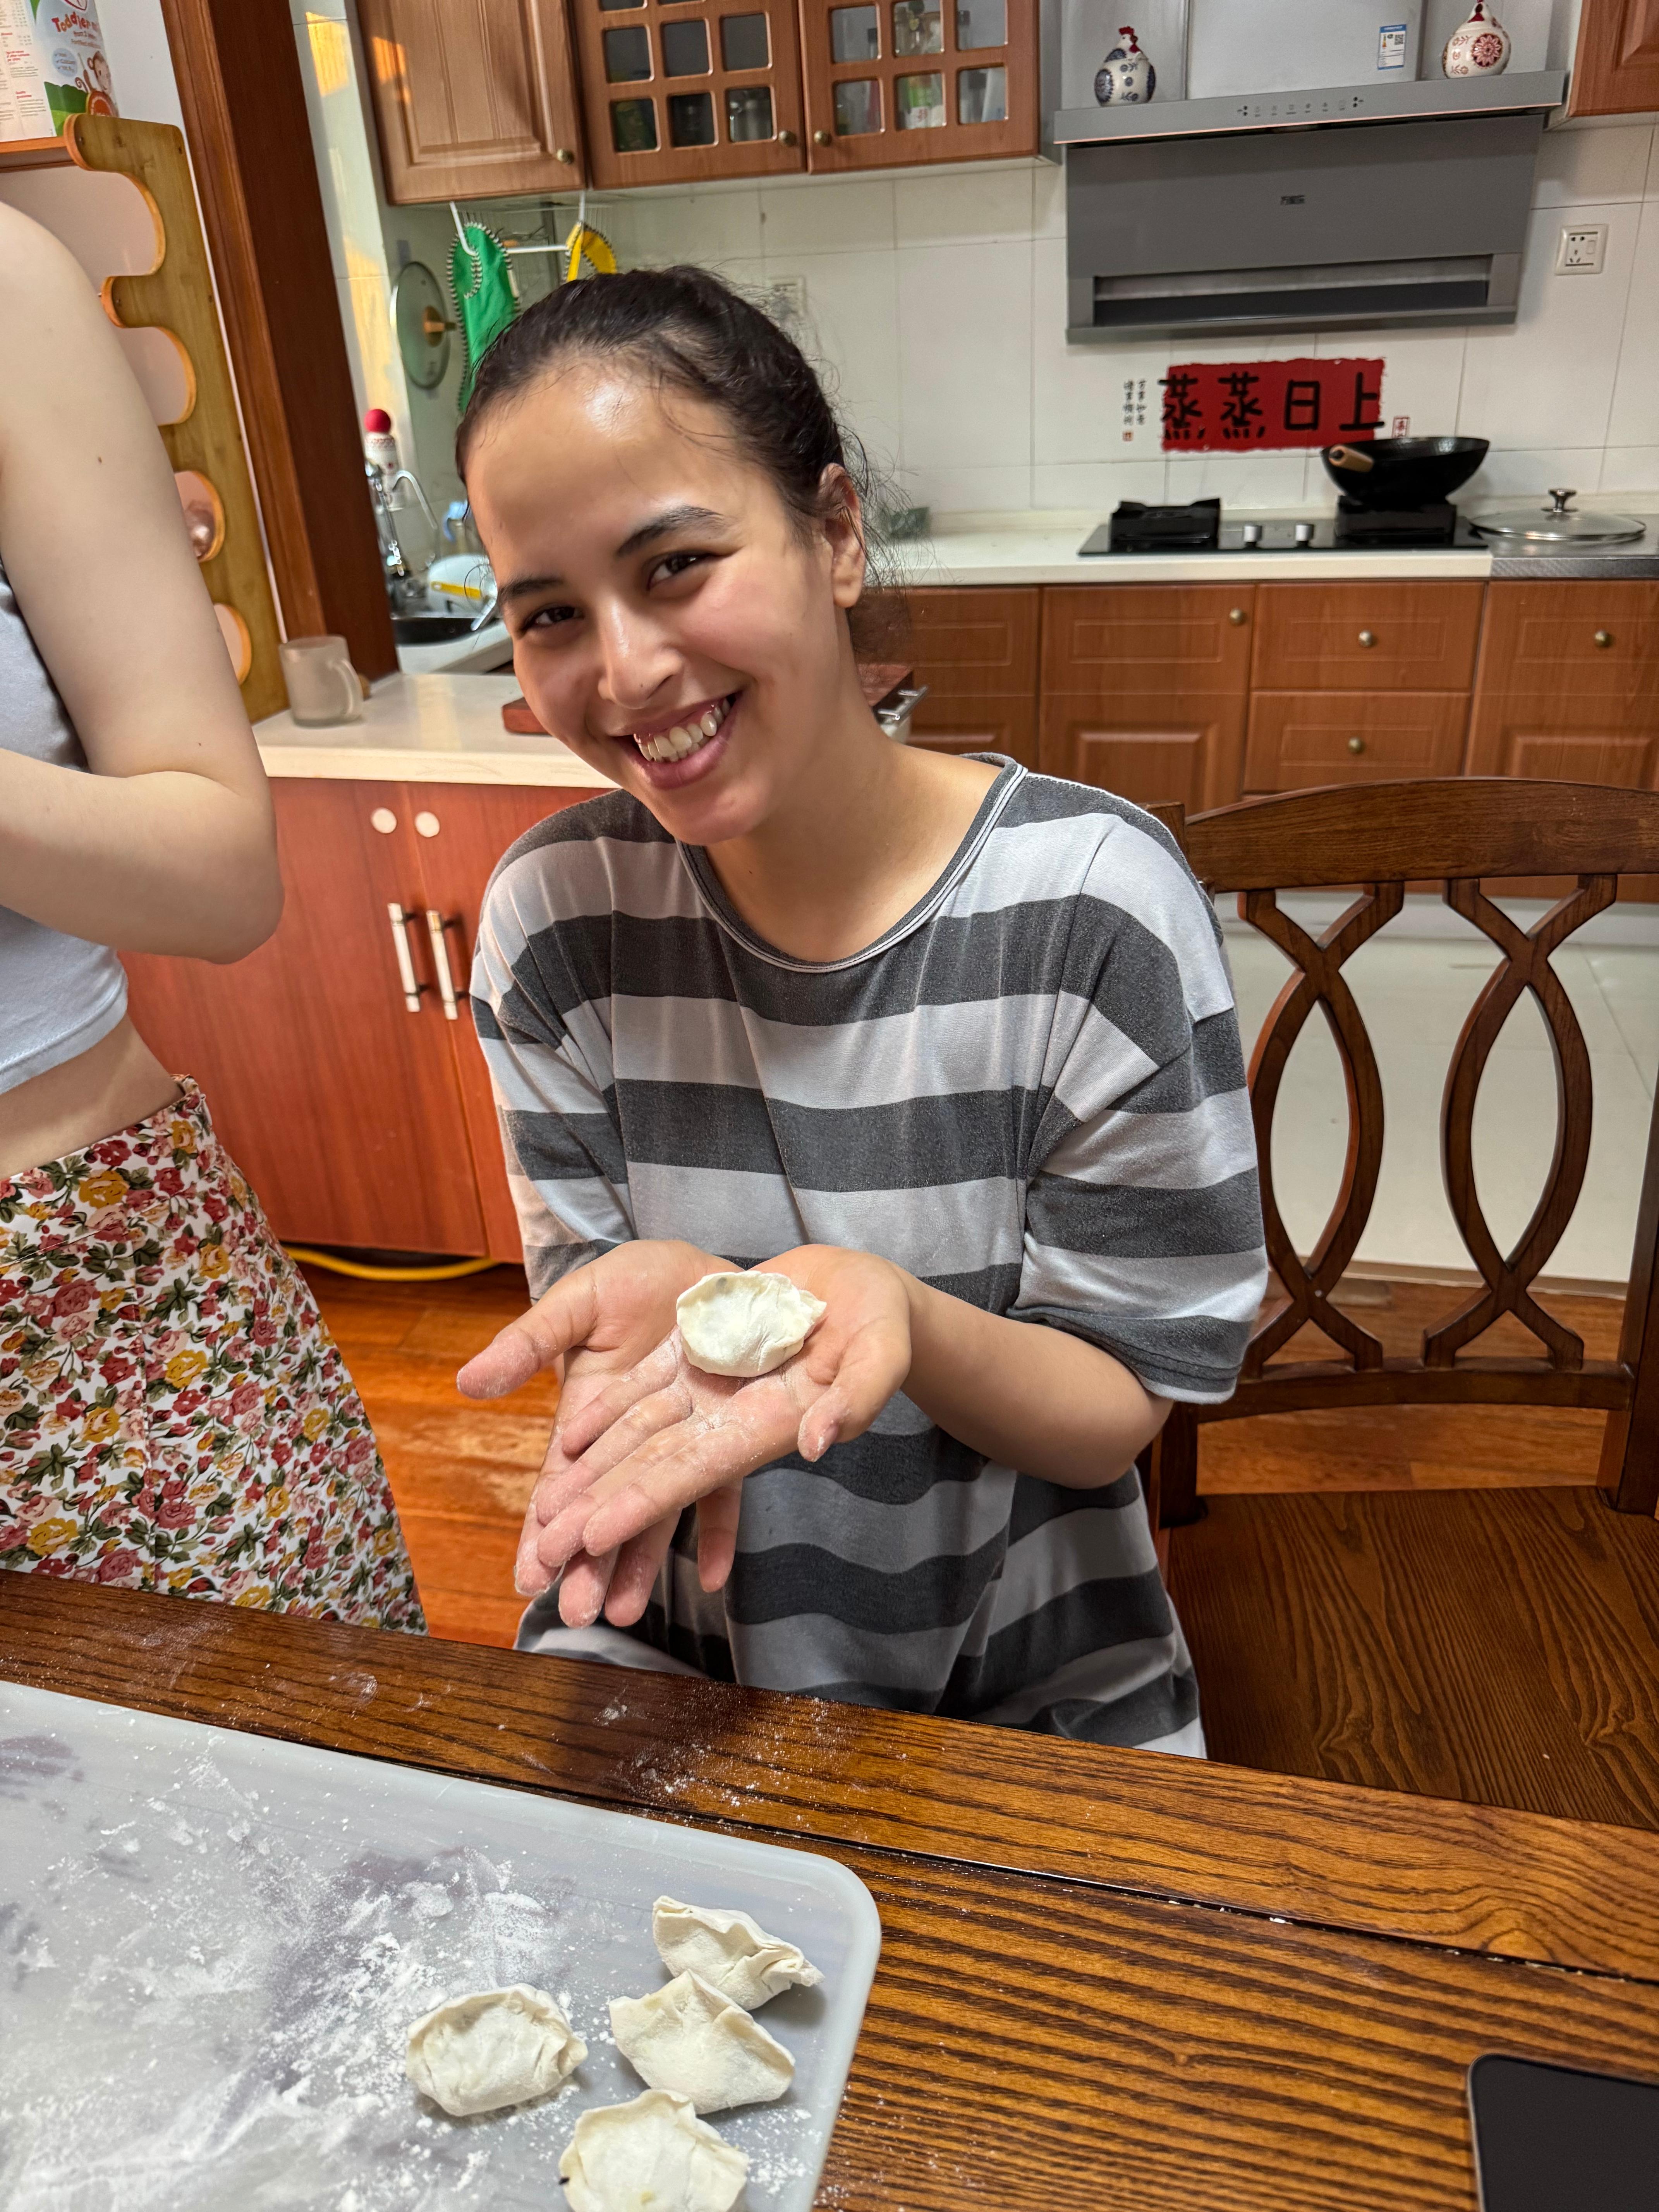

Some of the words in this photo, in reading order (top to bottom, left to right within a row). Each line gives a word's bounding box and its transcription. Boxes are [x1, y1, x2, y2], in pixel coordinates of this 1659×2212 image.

[51, 11, 91, 33] Toddler
[1158, 371, 1384, 440] 蒸蒸日上
